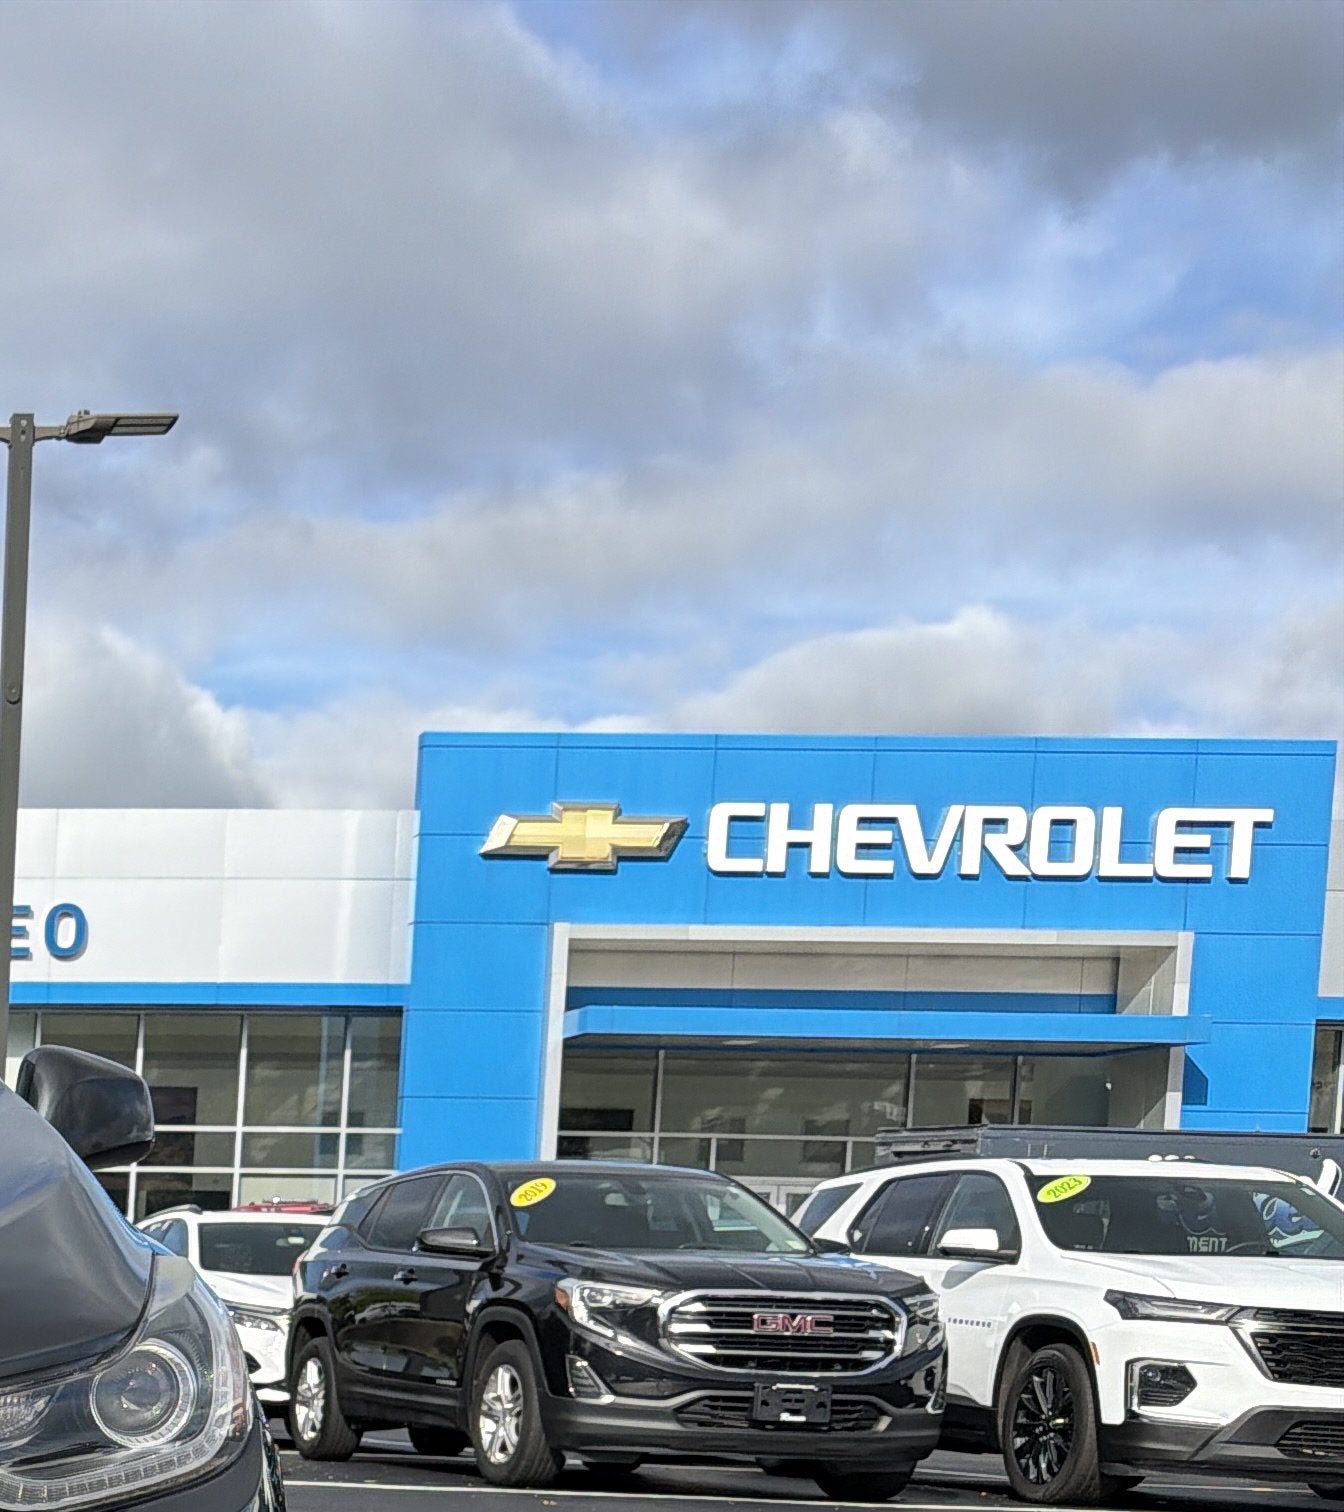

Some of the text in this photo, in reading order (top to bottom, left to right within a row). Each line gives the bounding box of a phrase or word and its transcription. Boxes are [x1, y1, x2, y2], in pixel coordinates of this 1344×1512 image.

[706, 802, 1275, 883] CHEVROLET
[518, 1182, 548, 1202] 2019
[1046, 1177, 1083, 1198] 2023
[752, 1313, 834, 1335] GMC
